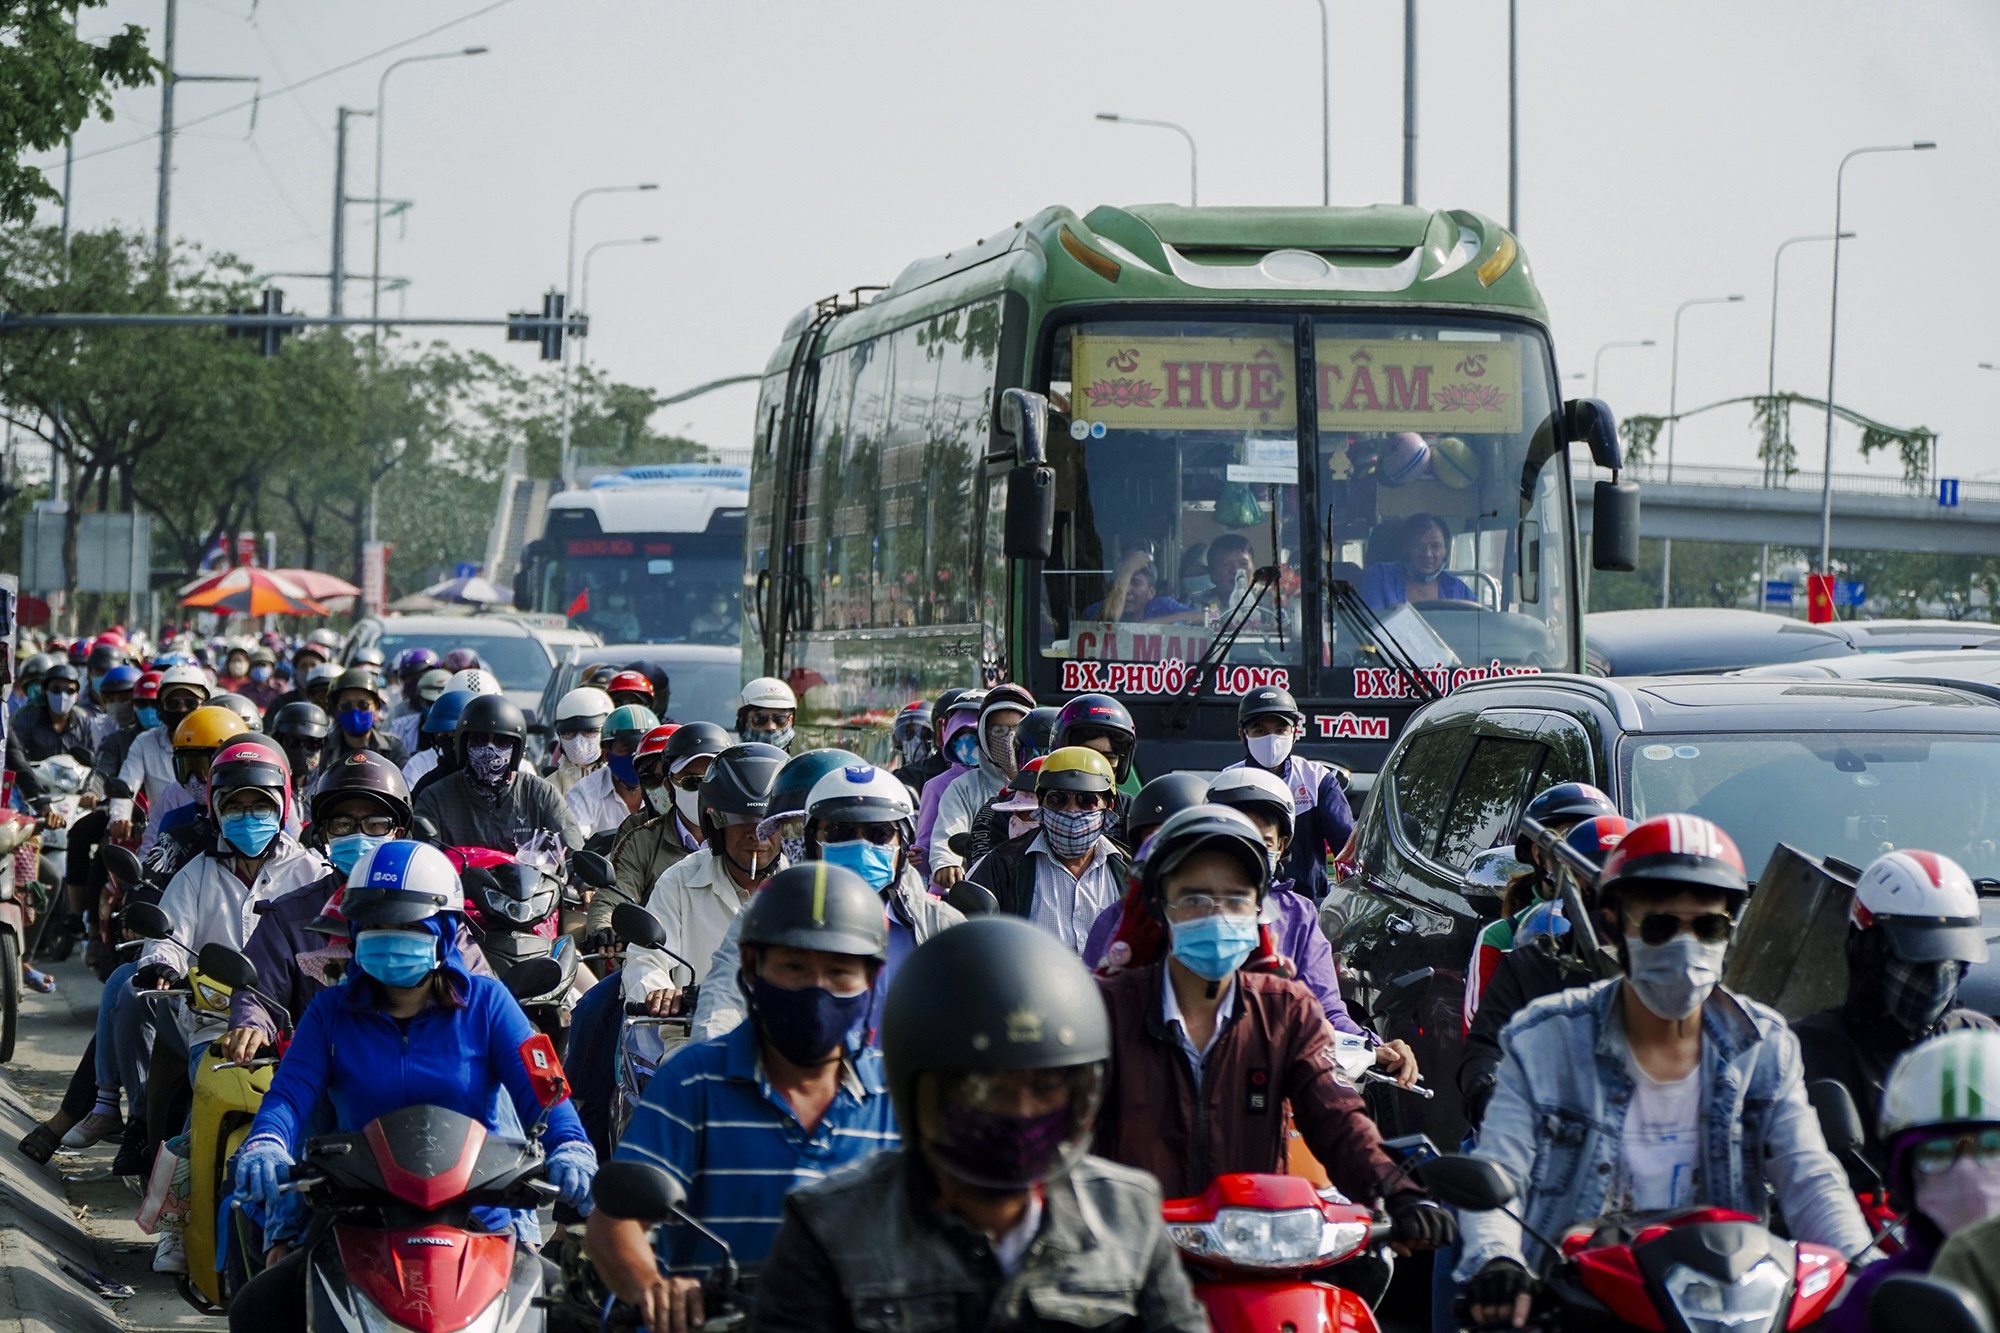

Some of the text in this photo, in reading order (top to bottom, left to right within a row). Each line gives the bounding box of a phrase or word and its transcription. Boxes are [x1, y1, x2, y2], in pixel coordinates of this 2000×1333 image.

[1161, 346, 1435, 423] HUỆ TÂM
[1214, 665, 1290, 697] LONG
[1314, 711, 1390, 739] TÂM
[406, 1237, 454, 1248] HONDA
